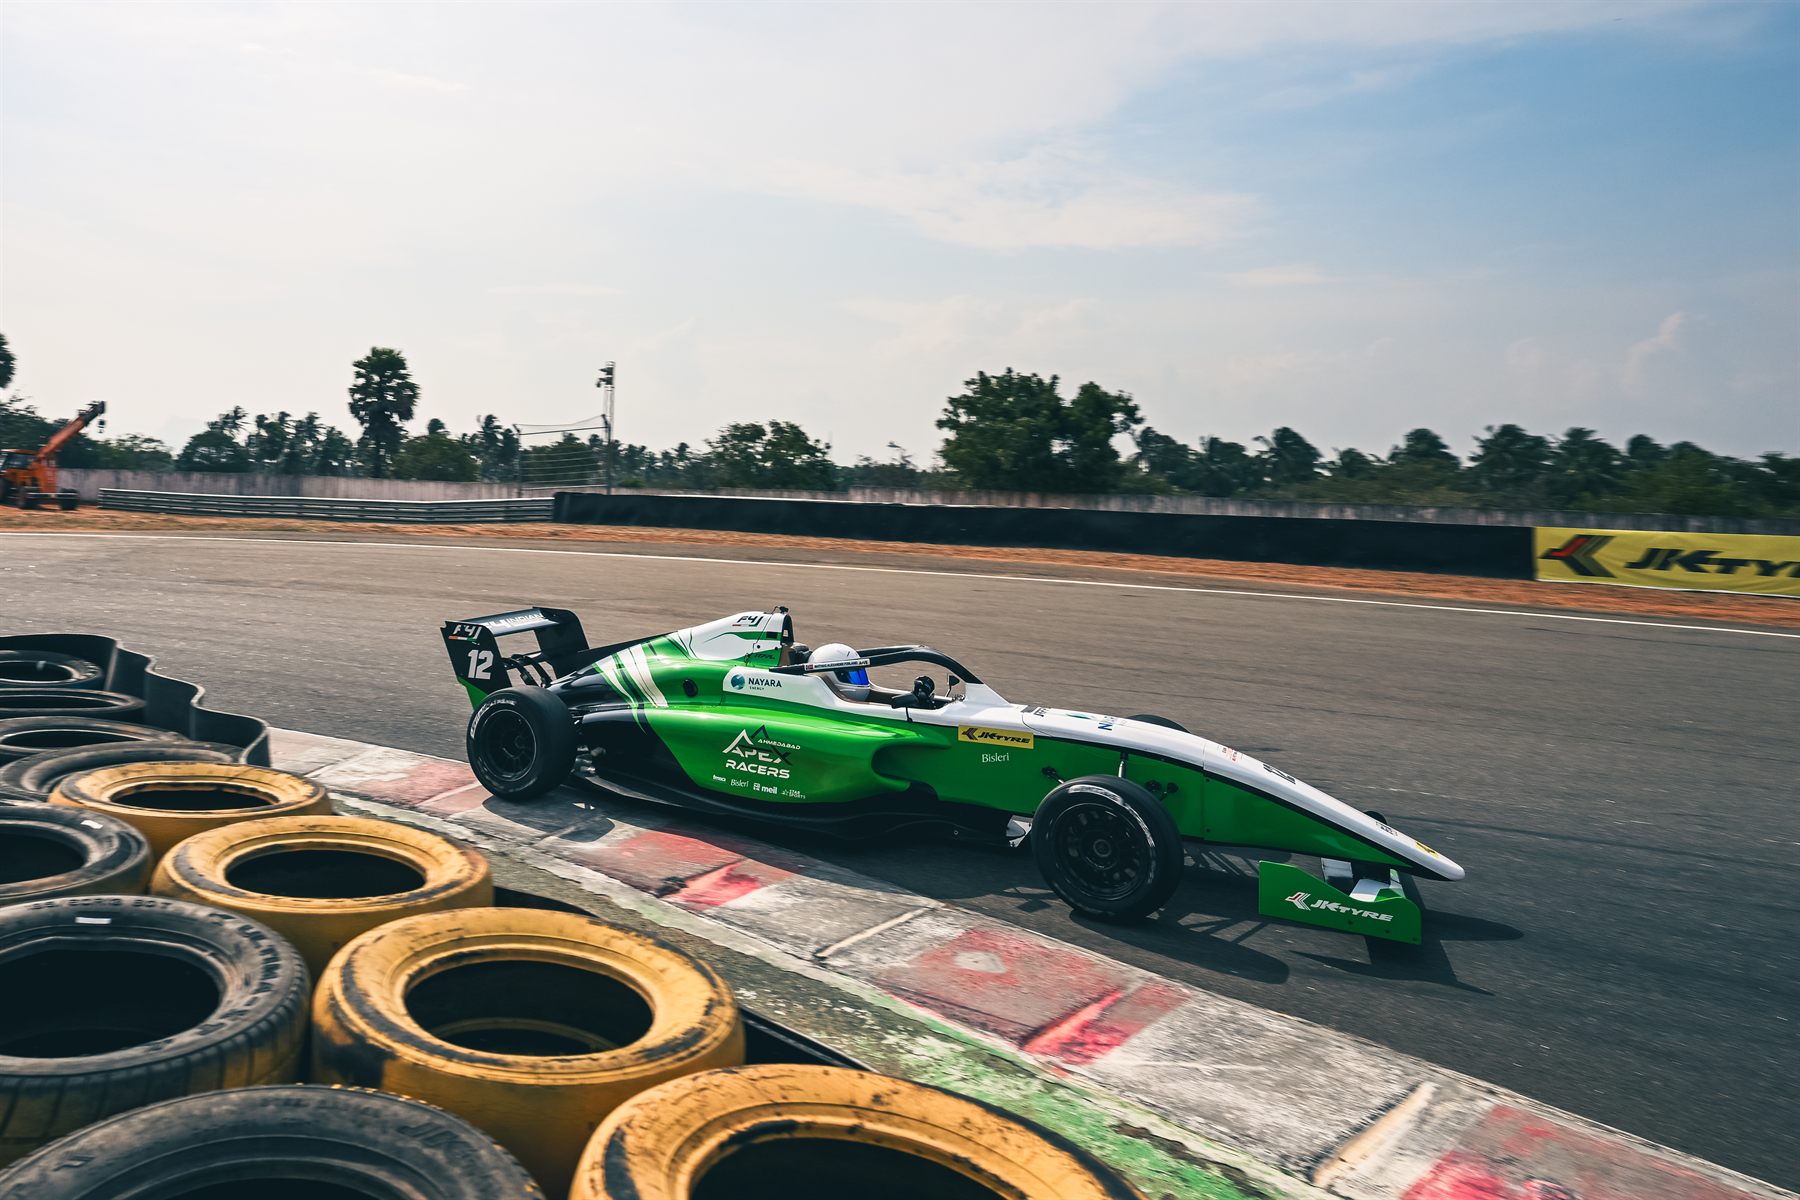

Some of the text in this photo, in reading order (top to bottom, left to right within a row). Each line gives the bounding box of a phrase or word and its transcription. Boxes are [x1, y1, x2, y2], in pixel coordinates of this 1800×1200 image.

[468, 650, 493, 679] 12
[748, 677, 782, 688] NAYARA
[758, 739, 800, 750] AHMEDABAD
[723, 737, 793, 767] APEX
[981, 752, 1010, 763] Bisleri
[725, 759, 791, 779] RACERS
[730, 778, 749, 788] Bisleri
[761, 785, 778, 795] meil
